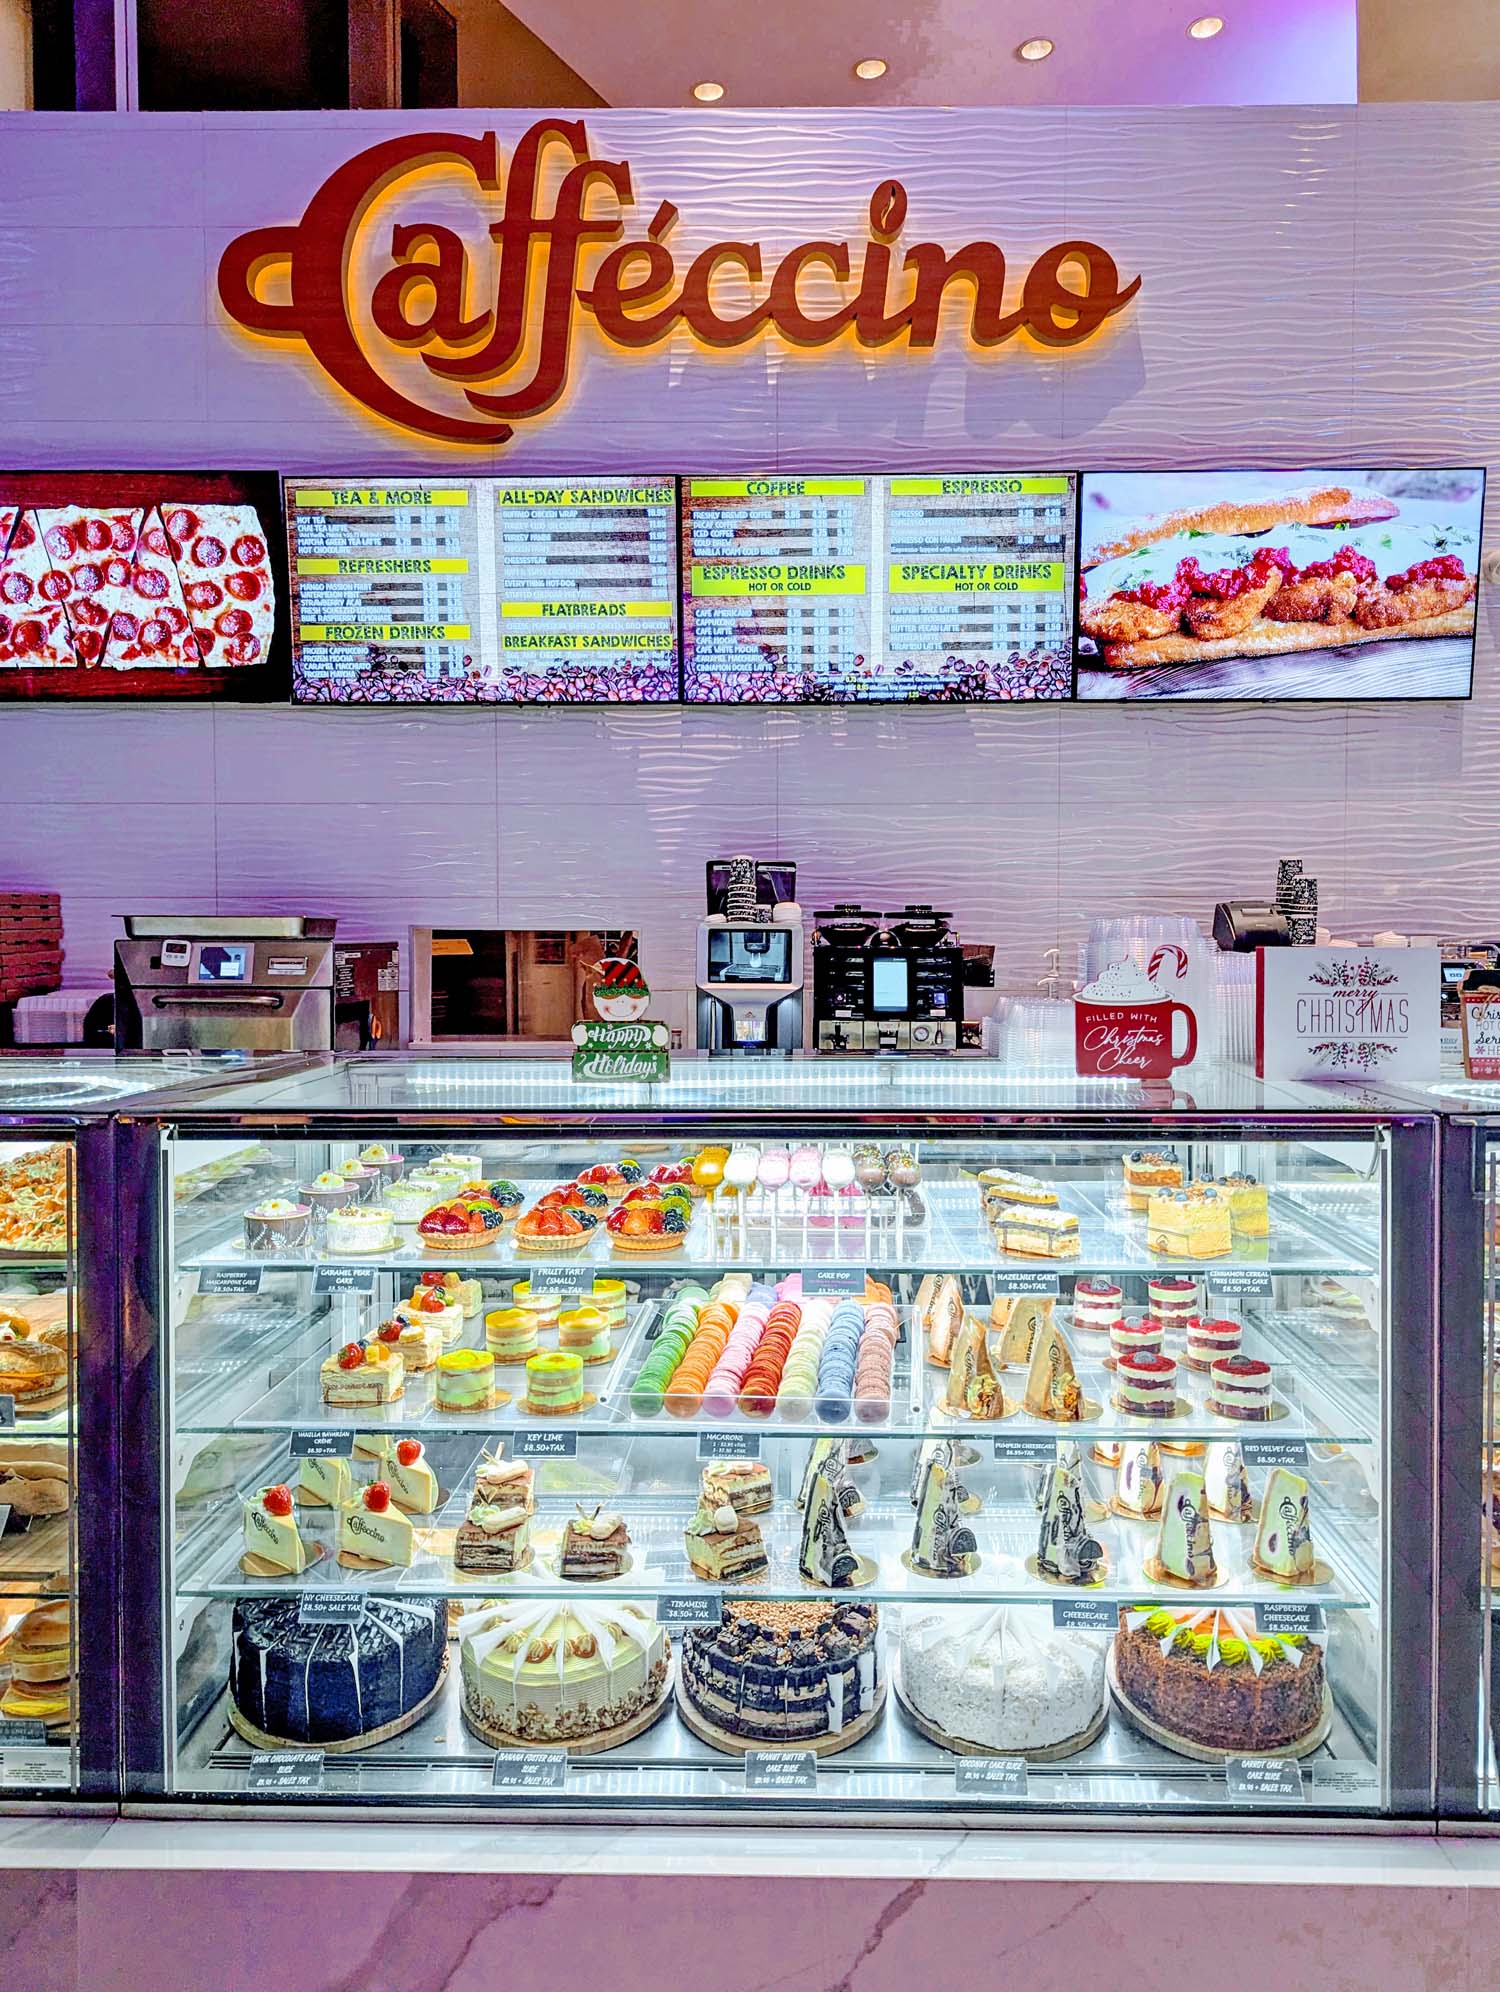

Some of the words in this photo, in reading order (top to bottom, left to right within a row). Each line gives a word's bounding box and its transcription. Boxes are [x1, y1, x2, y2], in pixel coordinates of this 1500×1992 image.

[217, 119, 1142, 445] Cafféccino
[746, 482, 805, 495] COFFEE
[942, 480, 1022, 494] ESPRESSO
[332, 491, 363, 505] TEA
[369, 491, 377, 504] &
[386, 491, 432, 504] MORE
[502, 490, 566, 504] ALL-DAY
[571, 489, 672, 504] SANDWICHES
[559, 510, 578, 518] WRAP
[693, 511, 719, 519] FRESHLY
[722, 511, 748, 519] BREWED
[751, 511, 772, 519] COFFEE
[694, 529, 709, 538] ICED
[710, 529, 734, 538] COFFEE
[298, 538, 324, 546] MATCHA
[326, 538, 348, 546] GREEN
[349, 538, 361, 546] TEA
[362, 538, 381, 546] LATTE
[694, 539, 711, 547] COLD
[338, 560, 431, 573] REFRESHERS
[703, 566, 781, 580] ESPRESSO
[787, 565, 846, 579] DRINKS
[902, 565, 987, 580] SPECIALTY
[993, 564, 1051, 579] DRINKS
[749, 583, 766, 591] HOT
[771, 583, 783, 591] OR
[787, 583, 811, 591] COLD
[955, 583, 973, 591] HOT
[977, 583, 990, 591] OR
[994, 583, 1018, 591] COLD
[542, 604, 626, 616] FLATBREADS
[326, 626, 383, 639] FROZEN
[389, 625, 445, 639] DRINKS
[713, 627, 732, 635] LATTE
[504, 635, 577, 648] BREAKFAST
[583, 635, 671, 647] SANDWICHES
[303, 647, 327, 655] FROZEN
[735, 646, 758, 654] MOCHA
[697, 664, 730, 672] CINNAMON
[753, 664, 773, 672] LATTE
[1332, 988, 1379, 1016] merry
[1086, 1012, 1124, 1023] FILLED
[1130, 1012, 1158, 1023] WITH
[1297, 999, 1409, 1033] CHRISTMAS
[588, 1024, 651, 1048] Happy
[1084, 1025, 1166, 1051] Christmas
[1096, 1047, 1152, 1071] Cheer
[583, 1053, 657, 1080] Holidays
[537, 1268, 563, 1276] FRUIT
[565, 1268, 586, 1276] TART
[546, 1277, 577, 1285] (SMALL)
[997, 1273, 1035, 1281] HAZELNUT
[1008, 1282, 1047, 1290] $8.50+TAX
[527, 1433, 542, 1441] KEY
[543, 1433, 564, 1441] LIME
[706, 1433, 744, 1441] MACARONS
[523, 1444, 565, 1452] $8.50+TAX
[1260, 1445, 1285, 1453] VELVET
[315, 1594, 360, 1602] CHEESECAKE
[303, 1603, 327, 1611] $8.50+
[671, 1600, 708, 1608] TIRAMISU
[1264, 1604, 1308, 1612] RASPBERRY
[1063, 1611, 1110, 1620] CHEESECAKE
[1263, 1614, 1311, 1622] CHEESECAKE
[1268, 1624, 1308, 1632] $8.50+TAX
[253, 1755, 271, 1763] DARK
[270, 1754, 305, 1763] CHOCOLATE
[305, 1754, 321, 1762] CAKE
[757, 1753, 782, 1761] PEANUT
[782, 1753, 807, 1761] BUTTER
[766, 1764, 783, 1773] CAKE
[782, 1764, 800, 1772] SLICE
[960, 1760, 989, 1768] COCONUT
[989, 1761, 1006, 1769] CAKE
[1006, 1762, 1024, 1770] SLICE
[1242, 1760, 1266, 1768] CARROT
[1266, 1761, 1284, 1769] CAKE
[277, 1765, 295, 1773] SLICE
[775, 1776, 795, 1784] SALES
[794, 1776, 808, 1784] TAX
[985, 1772, 1005, 1780] SALES
[1005, 1773, 1019, 1781] TAX
[1264, 1772, 1282, 1780] SLICE
[278, 1777, 297, 1785] SALES
[297, 1776, 311, 1784] TAX
[523, 1777, 542, 1785] SALES
[541, 1777, 555, 1785] TAX
[1260, 1784, 1279, 1792] SALES
[1280, 1784, 1294, 1793] TAX
